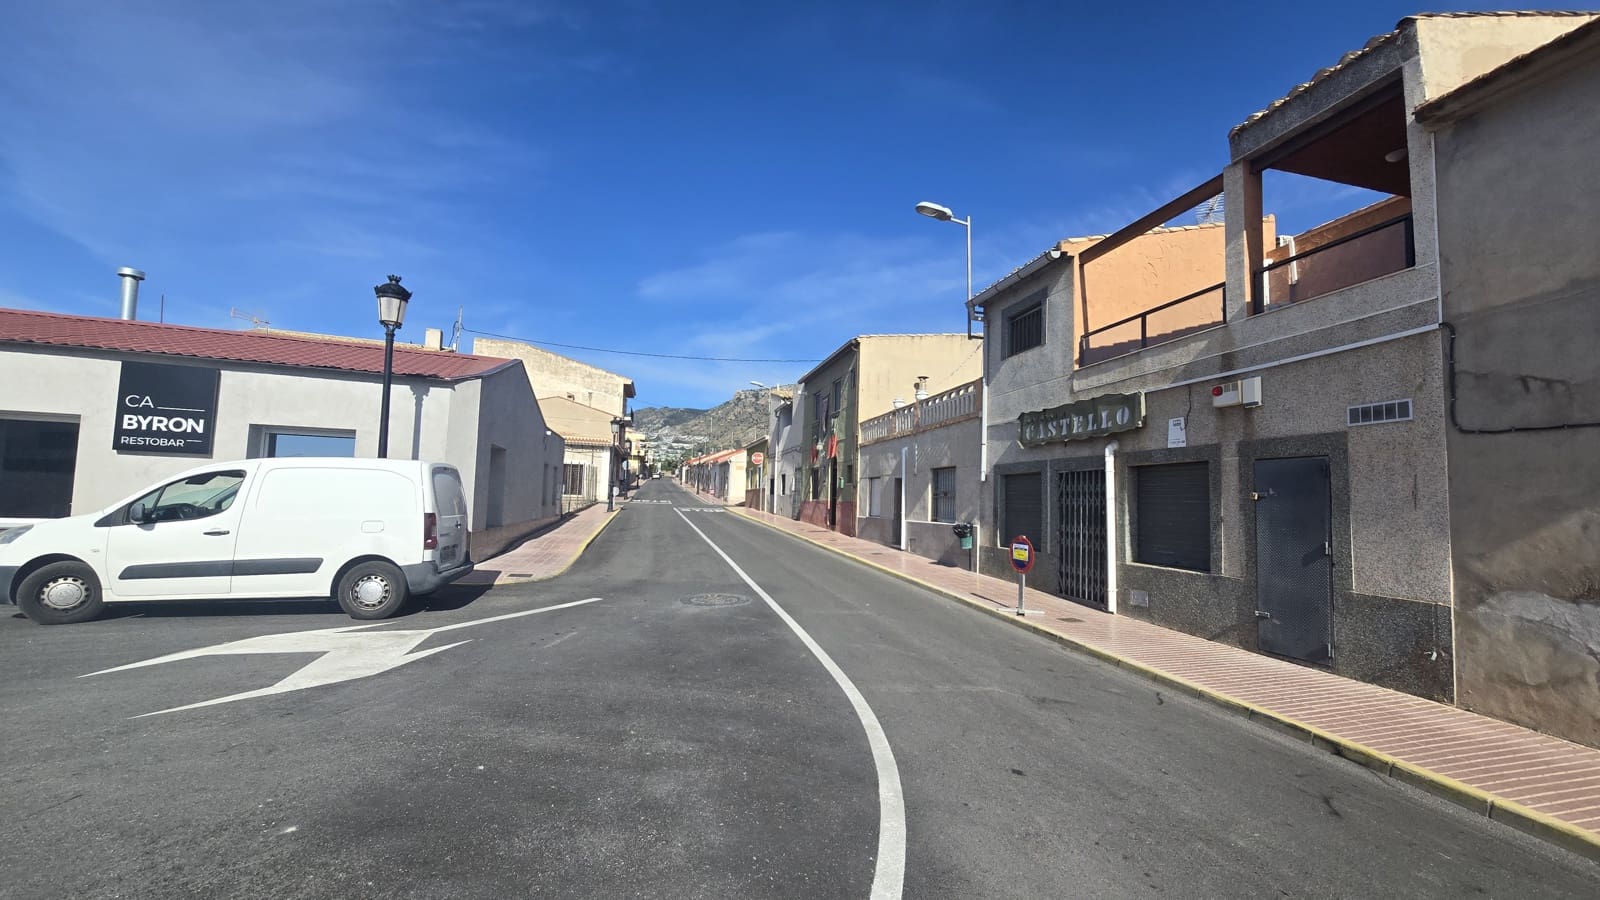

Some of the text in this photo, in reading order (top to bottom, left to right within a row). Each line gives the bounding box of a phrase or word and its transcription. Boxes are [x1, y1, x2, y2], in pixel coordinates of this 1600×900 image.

[125, 394, 154, 408] CA
[122, 414, 204, 434] BYRON
[1025, 405, 1130, 441] CASTELLO
[120, 436, 185, 447] RESTOBAR
